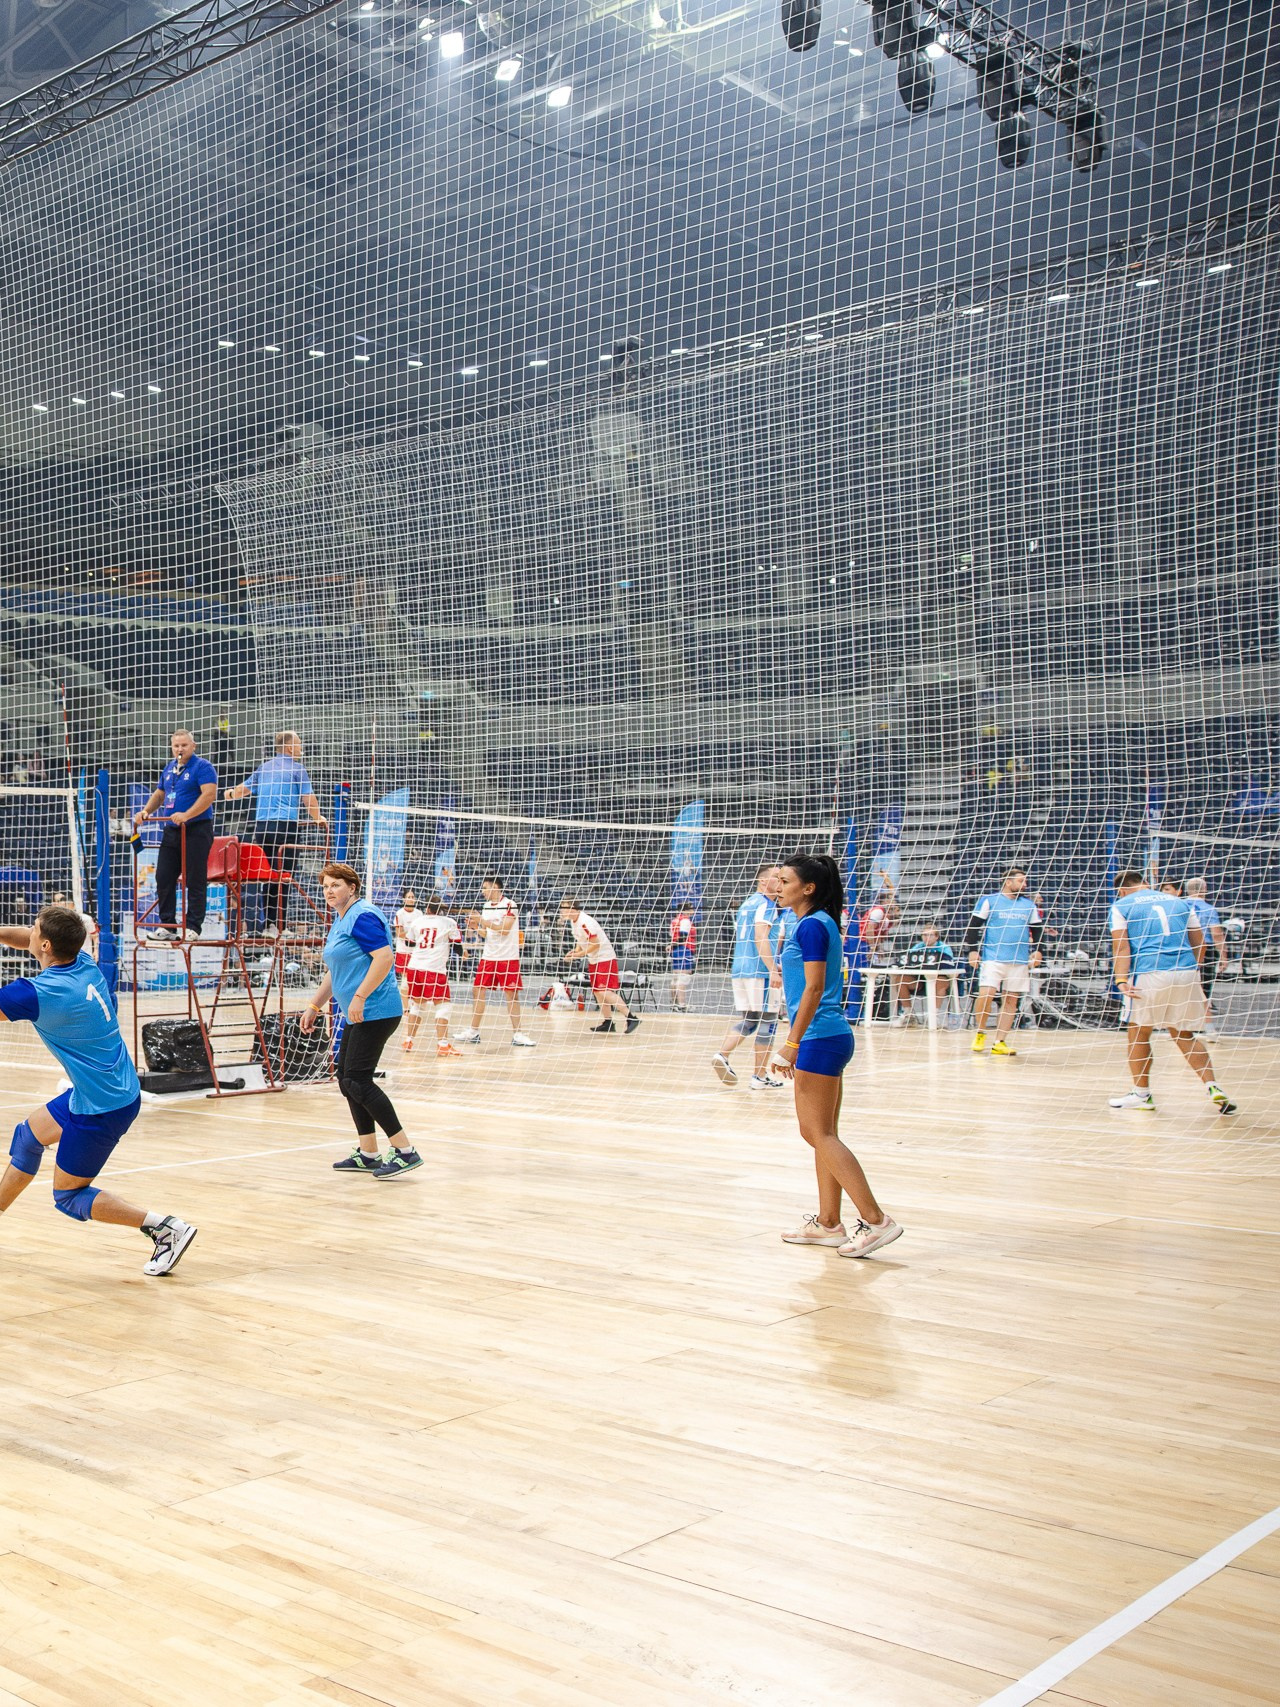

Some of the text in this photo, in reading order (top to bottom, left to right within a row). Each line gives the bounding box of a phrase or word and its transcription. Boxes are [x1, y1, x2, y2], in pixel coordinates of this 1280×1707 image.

[1151, 905, 1170, 936] 1
[419, 928, 438, 949] 31
[85, 983, 112, 1023] 1
